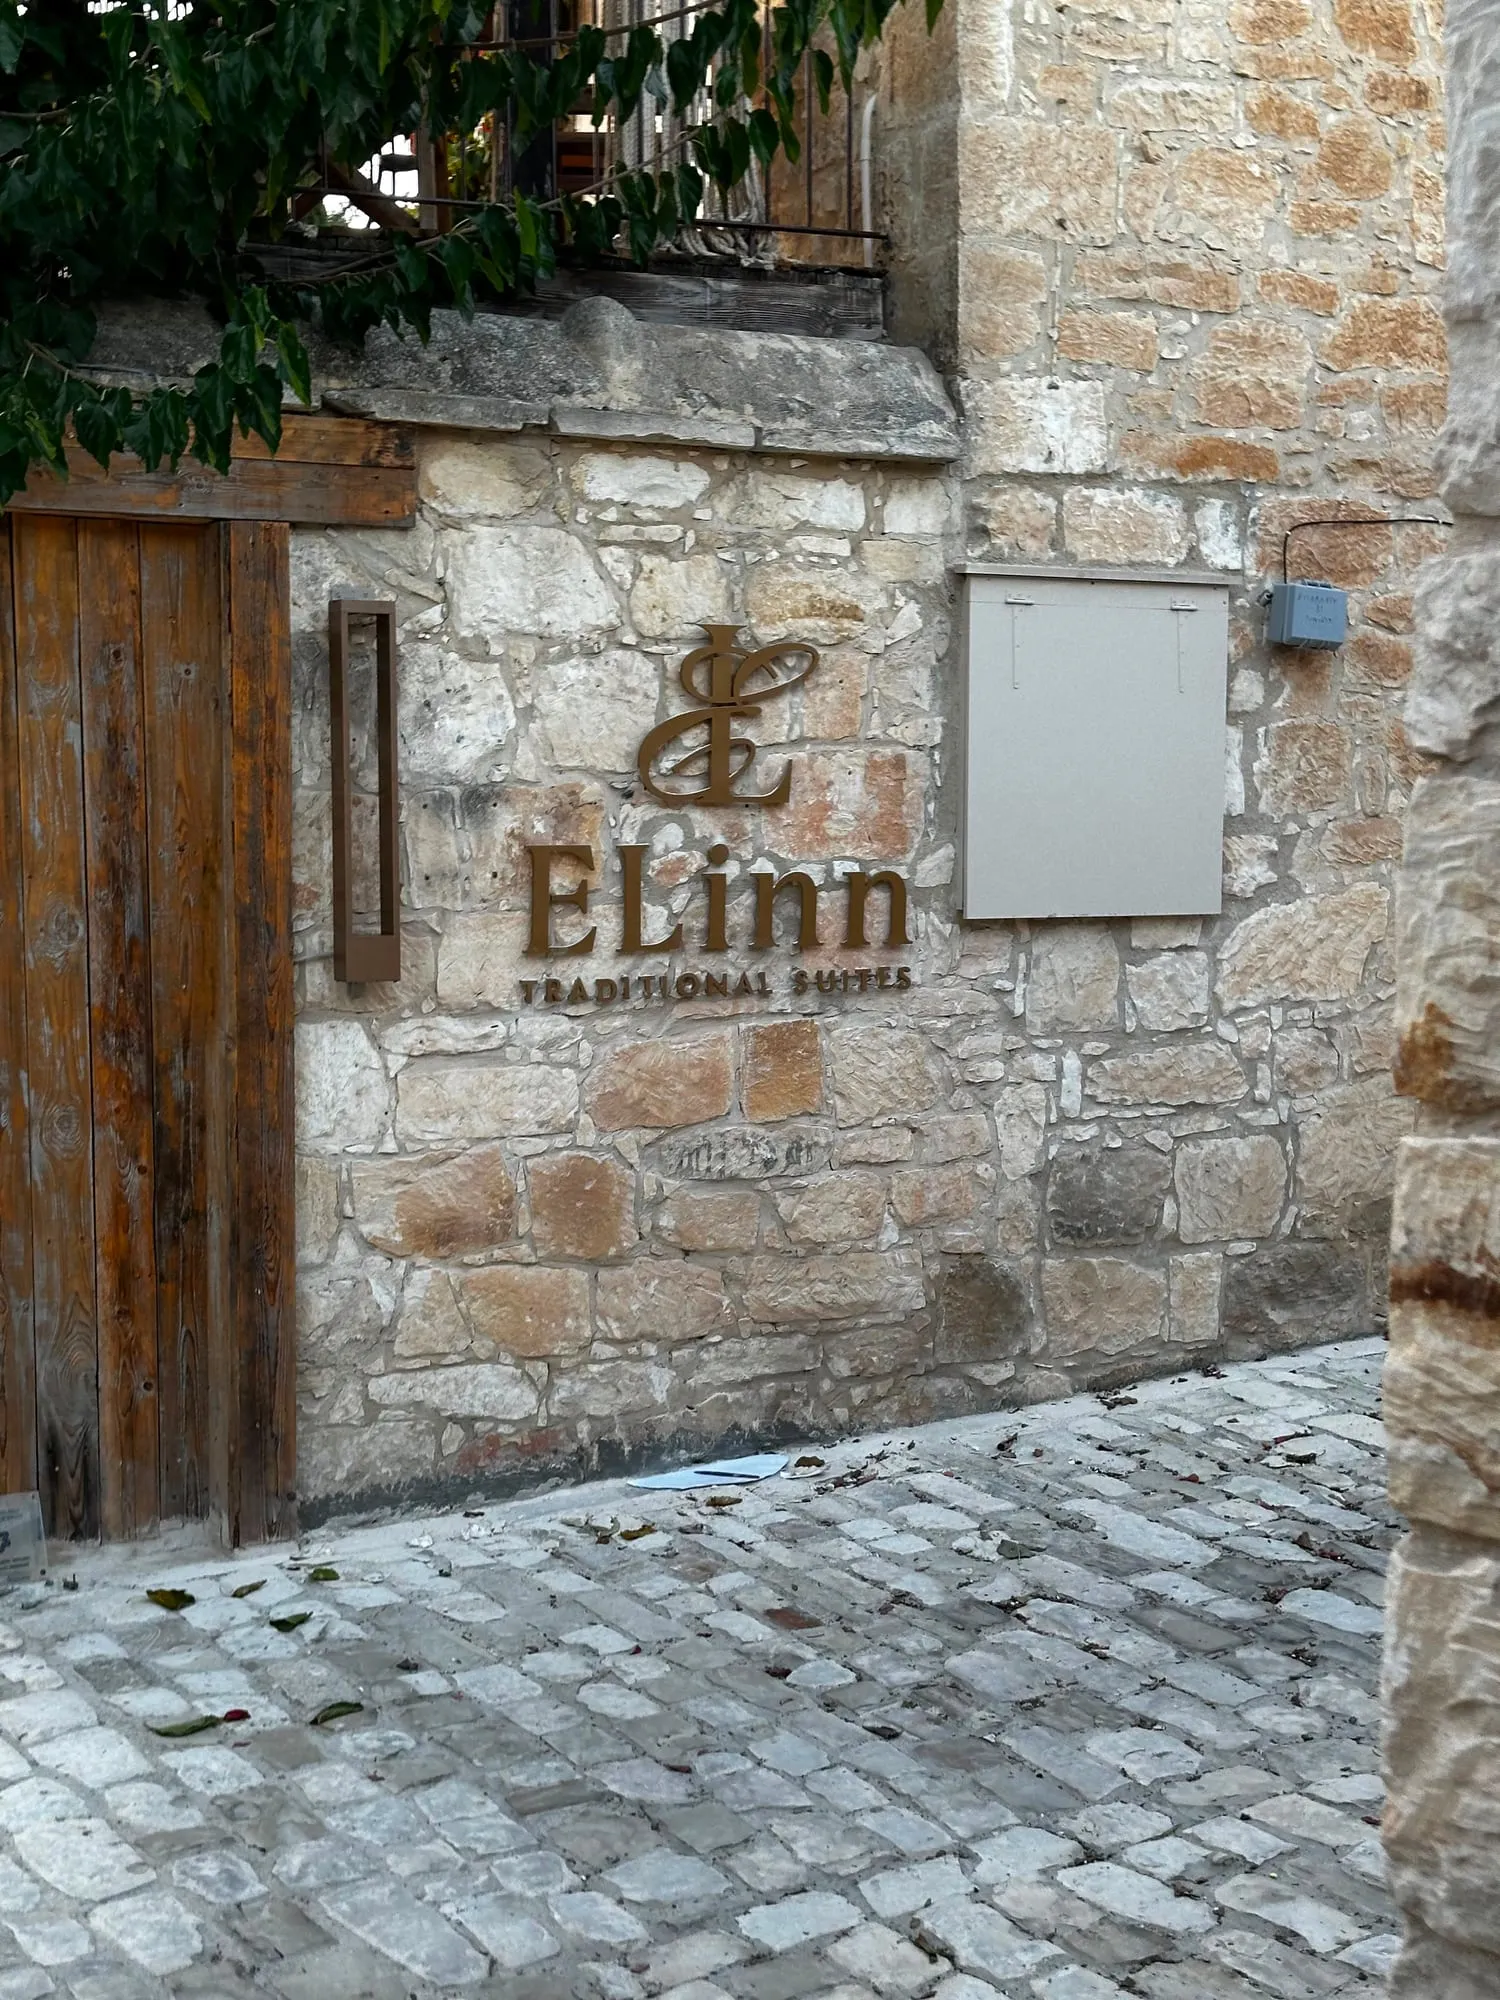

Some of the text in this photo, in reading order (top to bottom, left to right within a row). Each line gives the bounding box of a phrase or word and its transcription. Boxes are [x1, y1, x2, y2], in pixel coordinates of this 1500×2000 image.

[521, 842, 913, 954] ELinn
[518, 965, 913, 1004] TRADITIONAL SUITES
